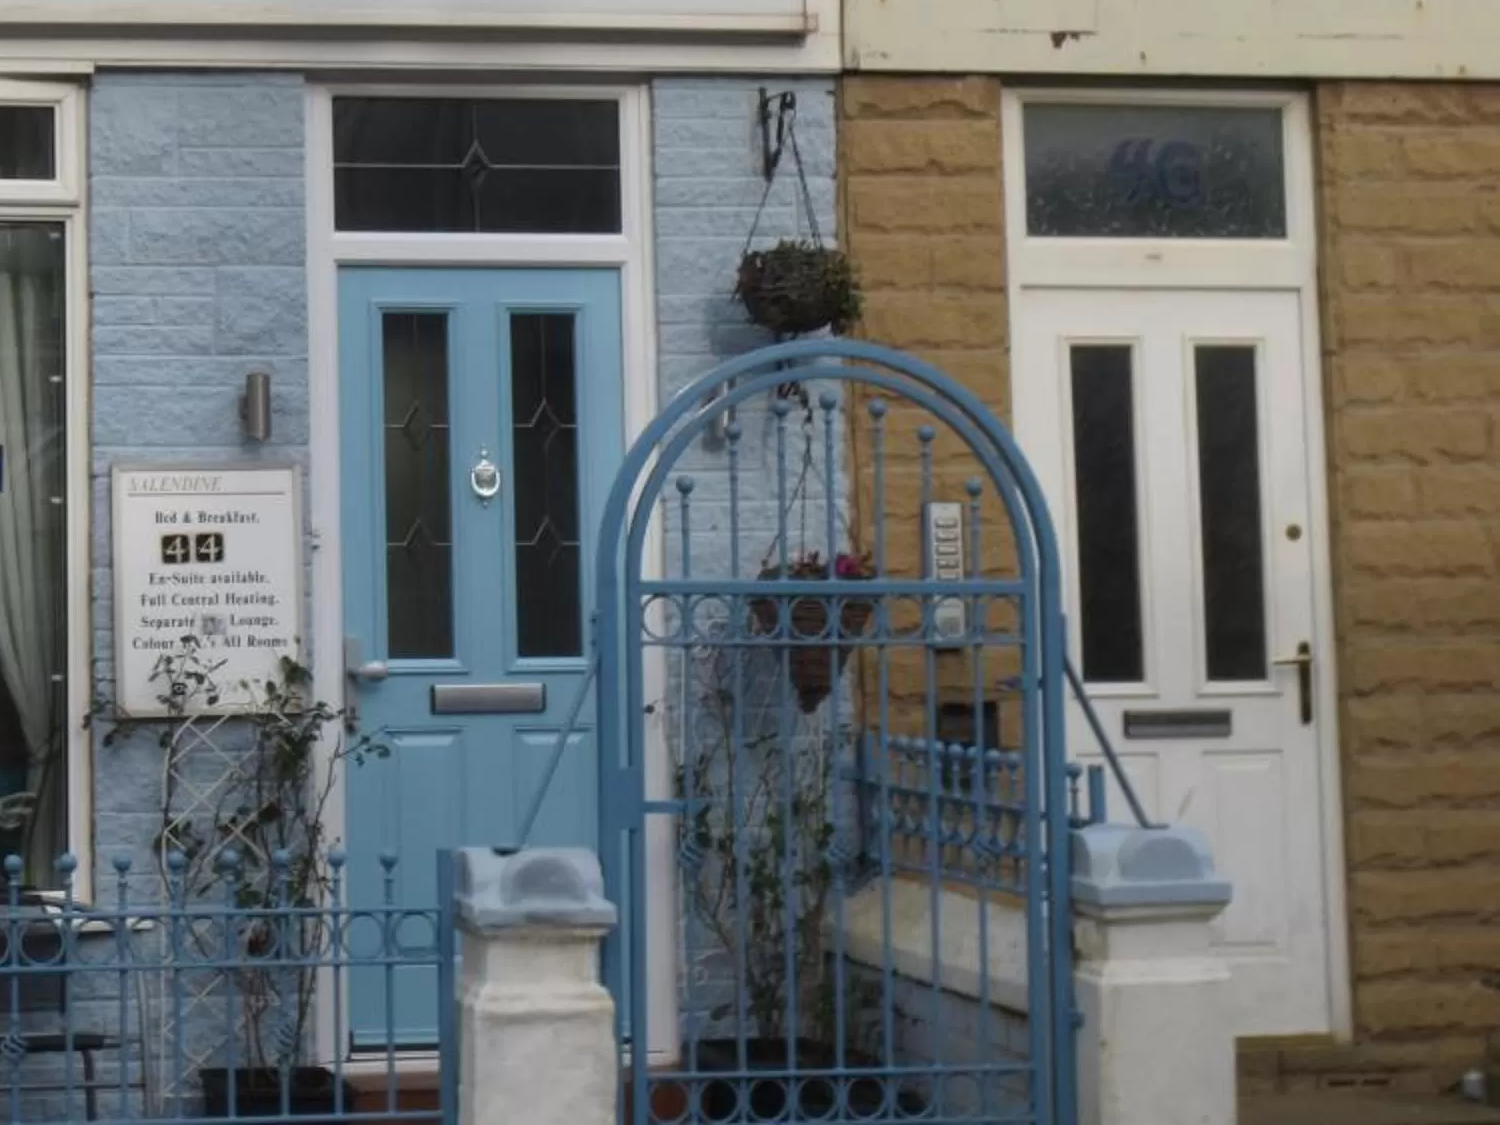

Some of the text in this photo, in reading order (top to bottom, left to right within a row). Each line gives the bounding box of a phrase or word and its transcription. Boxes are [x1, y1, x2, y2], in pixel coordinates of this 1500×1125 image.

[164, 533, 221, 563] 44
[141, 593, 167, 607] Full
[171, 593, 219, 606] Central
[140, 616, 196, 630] Separate
[132, 636, 175, 650] Colour
[223, 635, 241, 648] All
